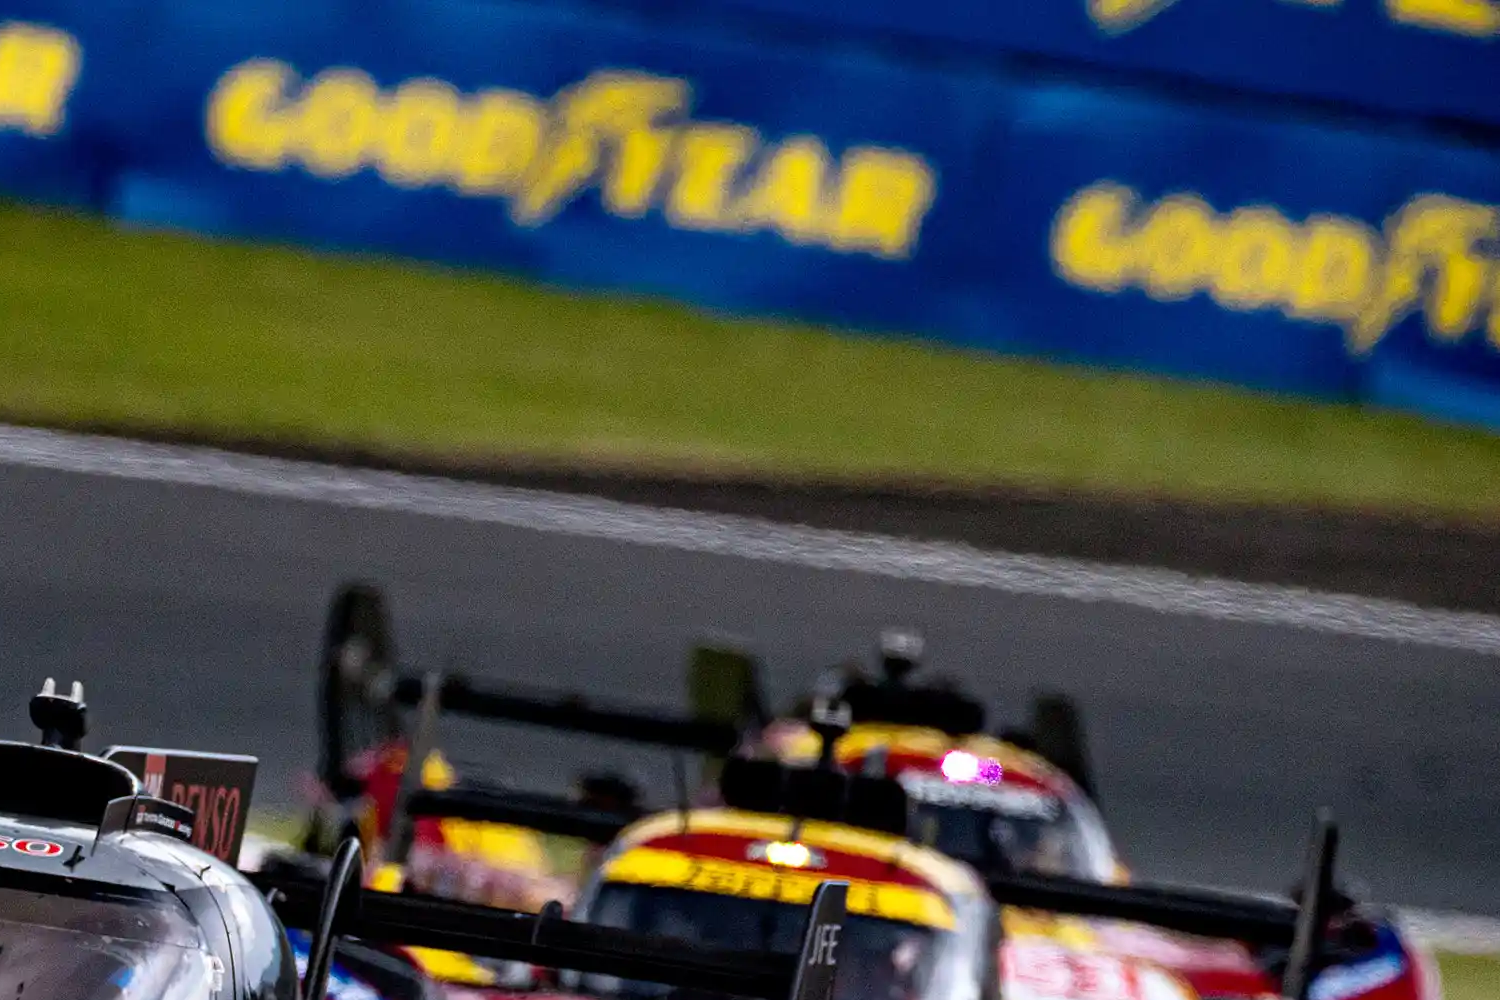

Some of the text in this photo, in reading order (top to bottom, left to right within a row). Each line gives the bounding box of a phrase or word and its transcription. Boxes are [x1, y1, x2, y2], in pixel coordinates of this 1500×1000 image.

[206, 57, 936, 260] GOODYEAR
[1050, 180, 1500, 356] GOODY
[808, 924, 842, 966] JFE
